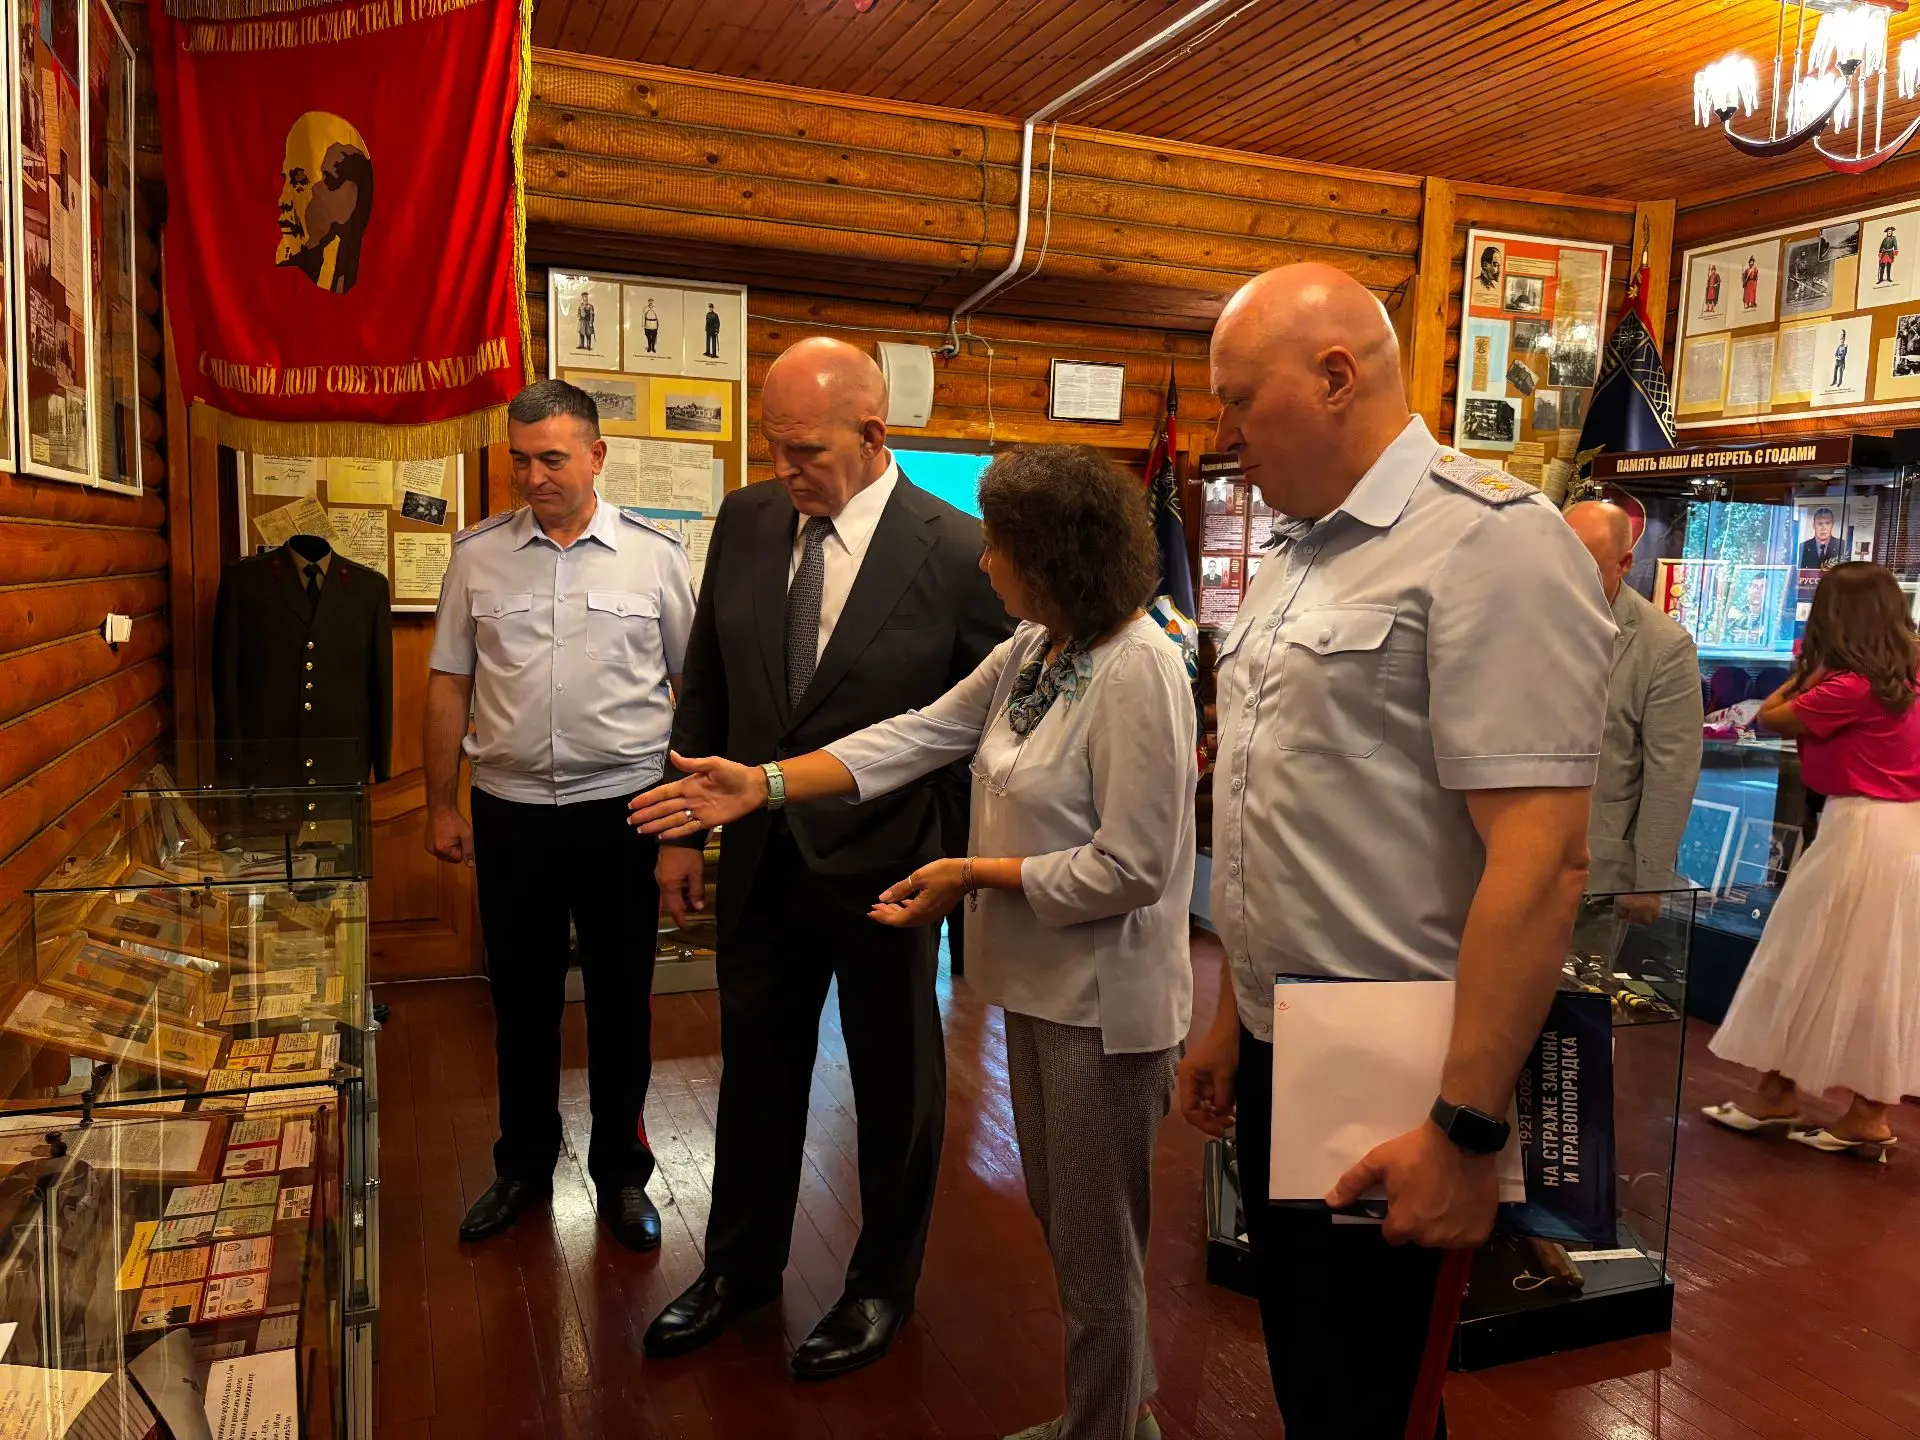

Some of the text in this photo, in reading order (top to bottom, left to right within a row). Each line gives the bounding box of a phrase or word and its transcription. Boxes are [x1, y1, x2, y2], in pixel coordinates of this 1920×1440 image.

[302, 2, 391, 45] ГОСУДАРСТВА
[279, 365, 323, 398] ДОЛГ
[326, 357, 425, 395] СОВЕТСКОЙ
[1616, 446, 1817, 473] ПАМЯТЬ НАШУ НЕ СТЕРЕТЬ С ГОДАМИ
[1541, 1030, 1559, 1187] НА СТРАЖЕ ЗАКОНА
[1562, 1037, 1580, 1183] И ПРАВОПОРЯДКА
